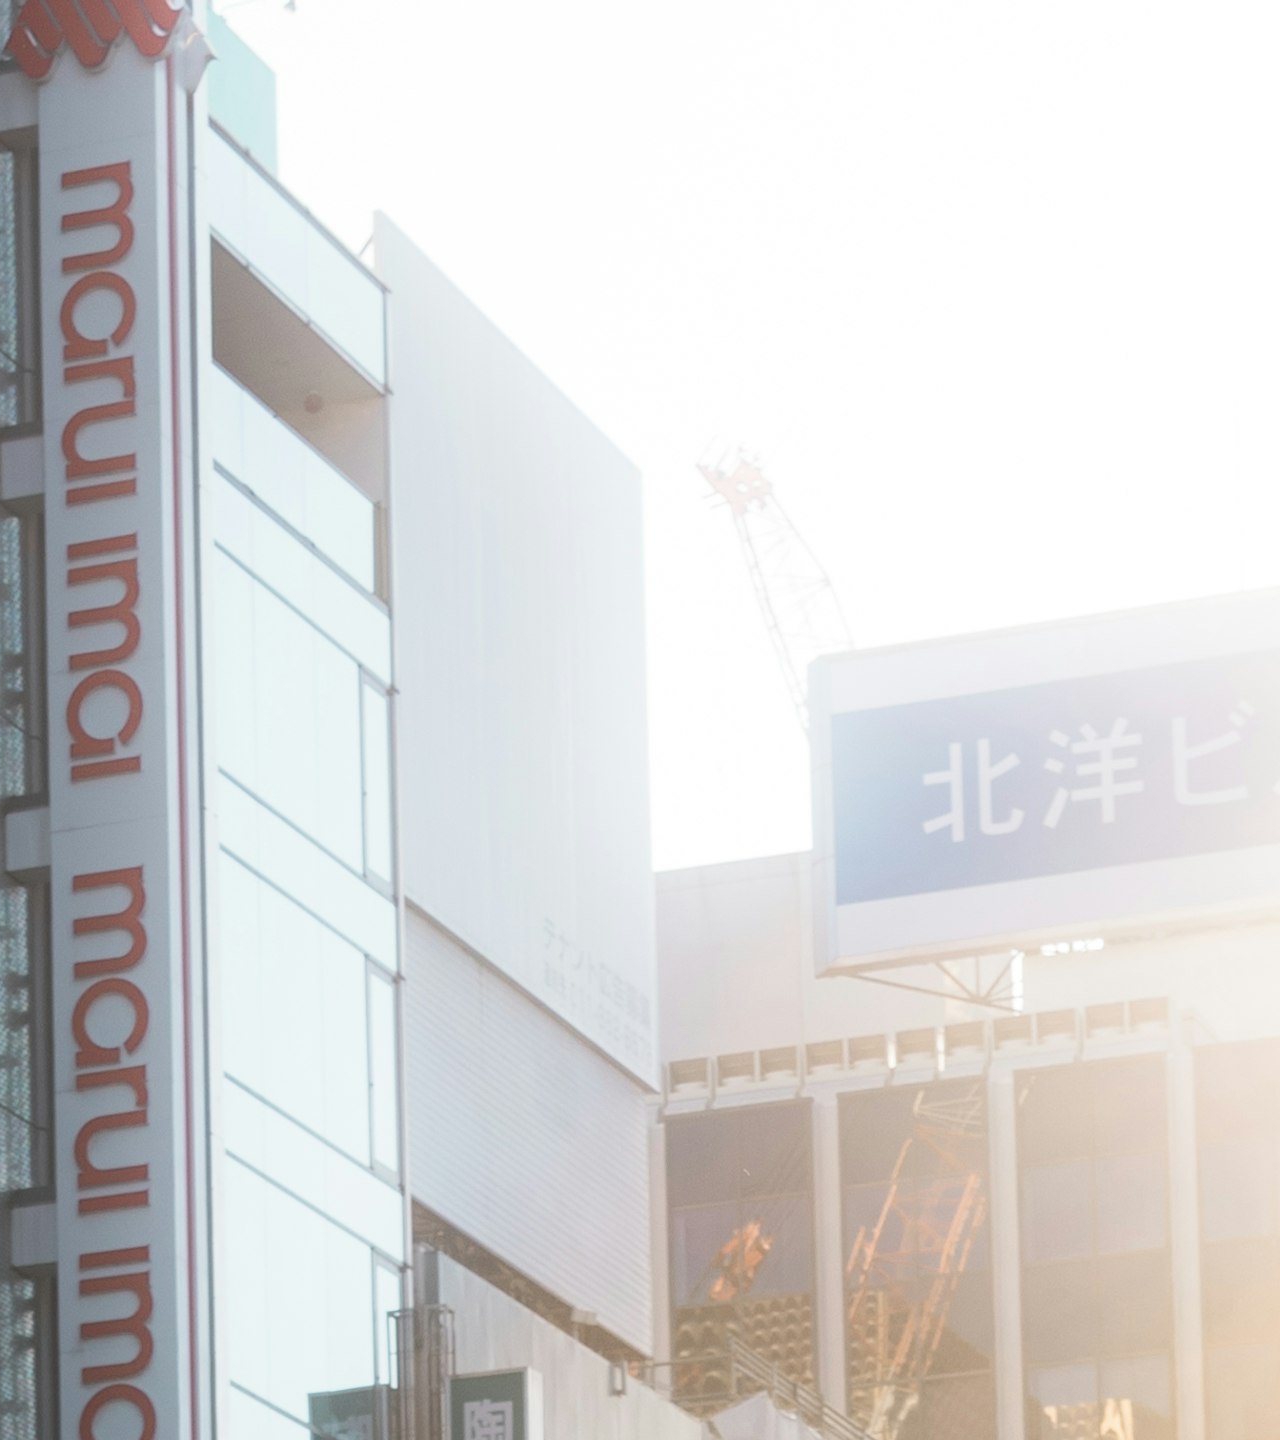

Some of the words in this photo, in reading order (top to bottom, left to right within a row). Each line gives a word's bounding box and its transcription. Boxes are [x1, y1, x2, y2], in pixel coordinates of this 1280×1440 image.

[59, 161, 137, 507] marui
[66, 532, 143, 782] imai
[71, 865, 150, 1215] marui
